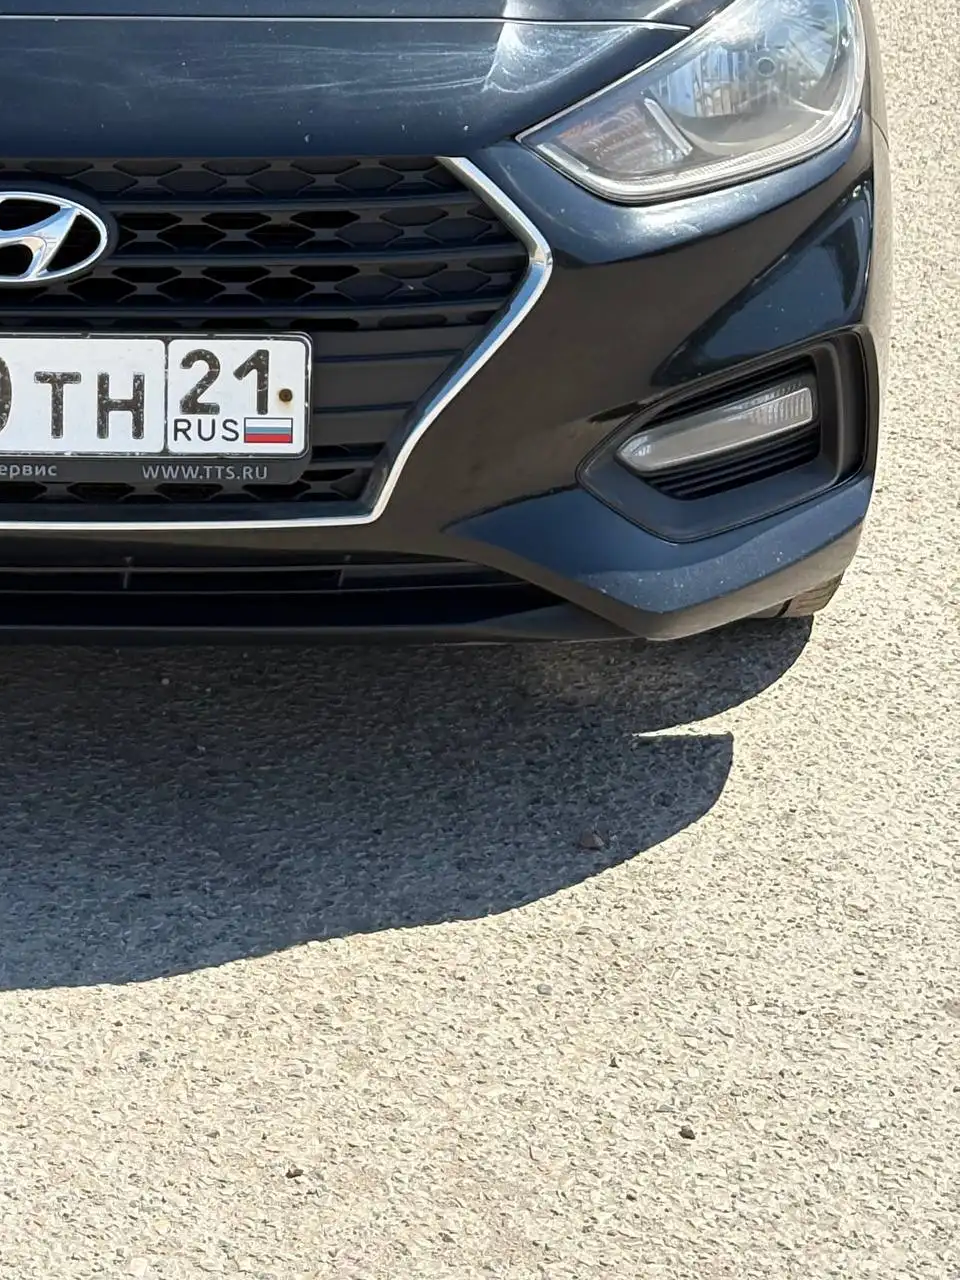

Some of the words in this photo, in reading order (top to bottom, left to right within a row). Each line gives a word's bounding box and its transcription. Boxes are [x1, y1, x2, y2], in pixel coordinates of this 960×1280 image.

[179, 349, 271, 415] 21
[172, 417, 241, 443] RUS
[142, 464, 269, 481] WWW.TTS.RU
